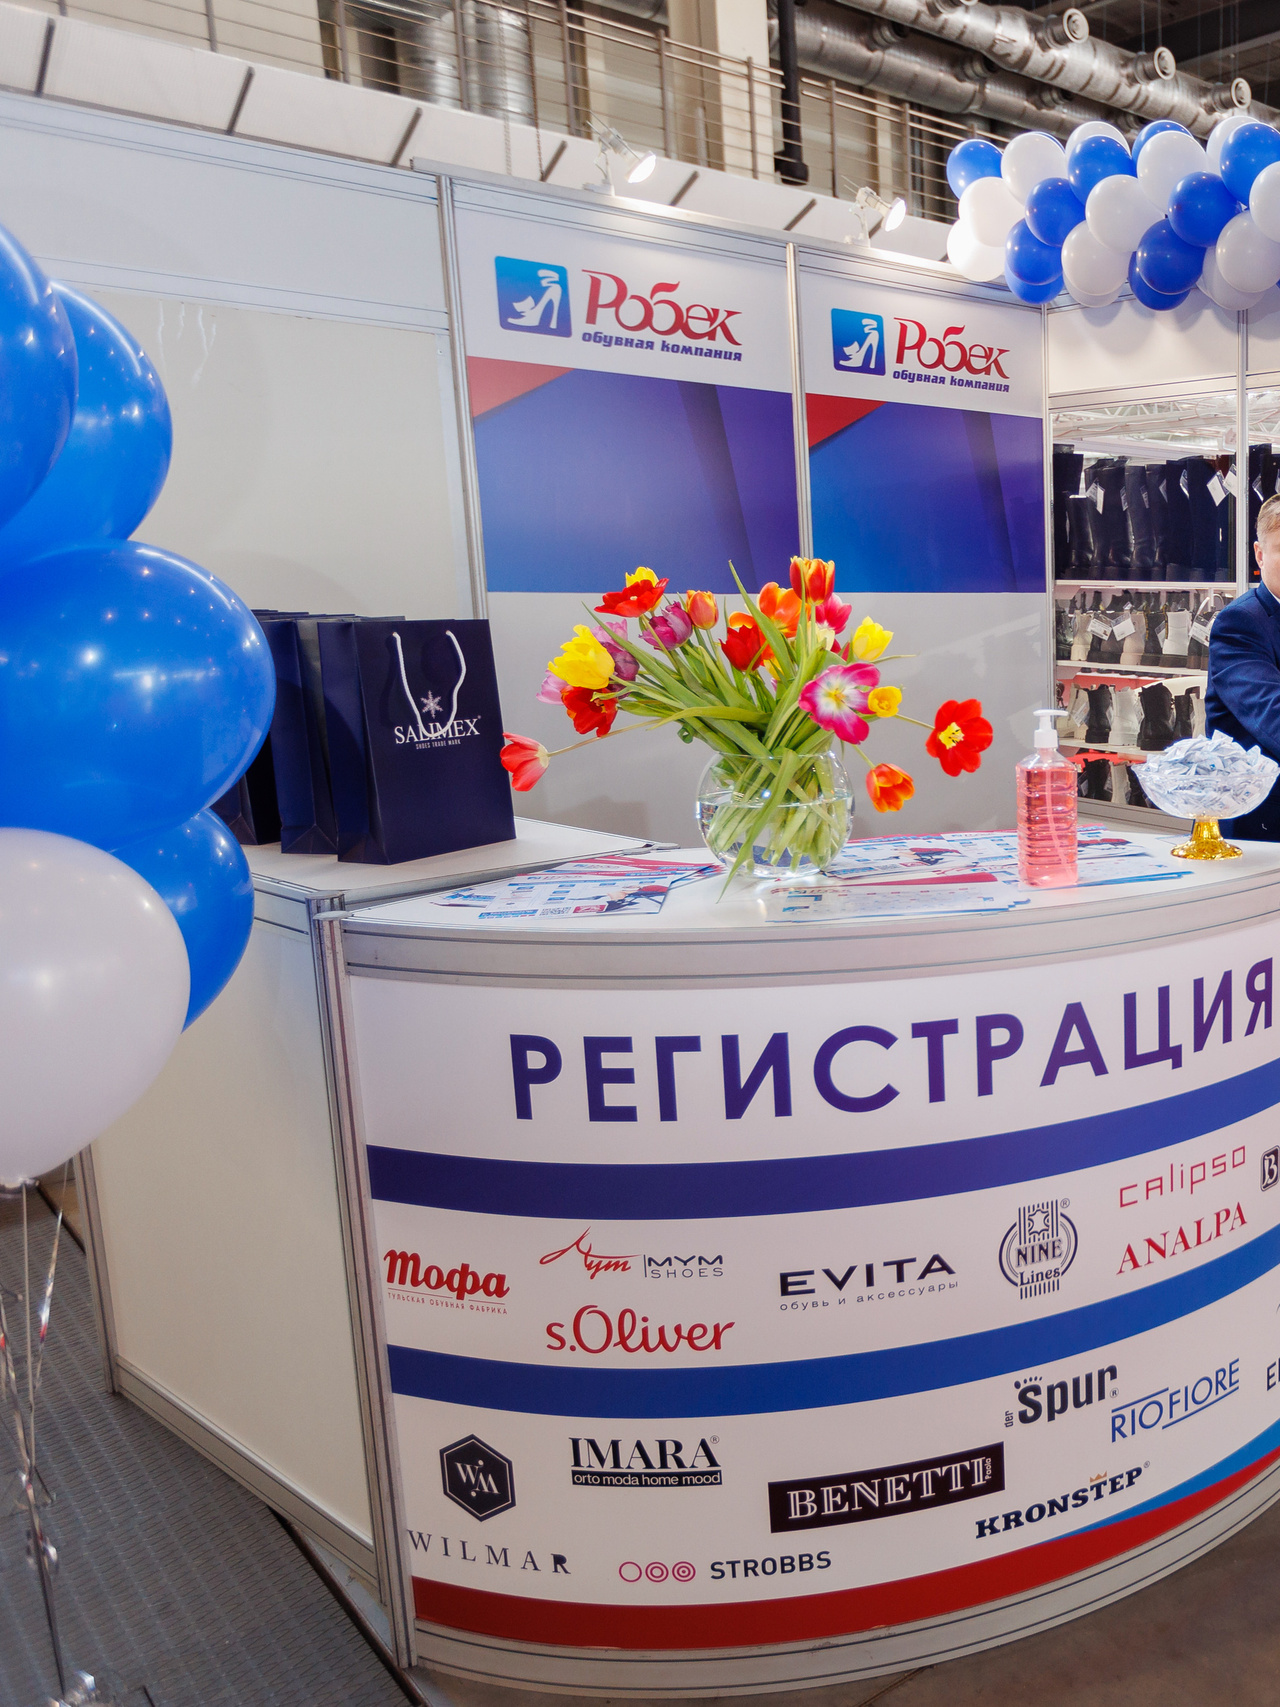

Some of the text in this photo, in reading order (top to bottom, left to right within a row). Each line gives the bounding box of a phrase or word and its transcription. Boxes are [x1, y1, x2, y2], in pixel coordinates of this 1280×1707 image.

[581, 269, 743, 346] Робек
[582, 331, 743, 362] обувная компания
[893, 317, 1011, 379] Робек
[893, 369, 1010, 393] обувная компания
[394, 718, 481, 744] SALIMEX
[509, 957, 1274, 1122] РЕГИСТРАЦИЯ
[1015, 1238, 1063, 1268] NINE
[1116, 1201, 1248, 1275] ANALPA
[647, 1254, 723, 1267] MYM
[650, 1267, 724, 1279] SHOES
[780, 1254, 957, 1297] EVITA
[1018, 1267, 1061, 1287] Lines
[387, 1292, 425, 1304] ТУЛЬСКАЯ
[780, 1301, 830, 1311] обувь
[856, 1281, 958, 1303] аксессуары
[546, 1304, 736, 1354] s.Oliver
[1018, 1365, 1117, 1424] Spur
[1004, 1411, 1014, 1428] der
[568, 1437, 722, 1470] IMARA
[574, 1472, 720, 1485] orto moda home mood
[787, 1456, 986, 1520] BENETTI
[975, 1466, 1142, 1539] KRONSTEP
[408, 1529, 572, 1575] WILMAR
[710, 1551, 832, 1580] STROBBS
